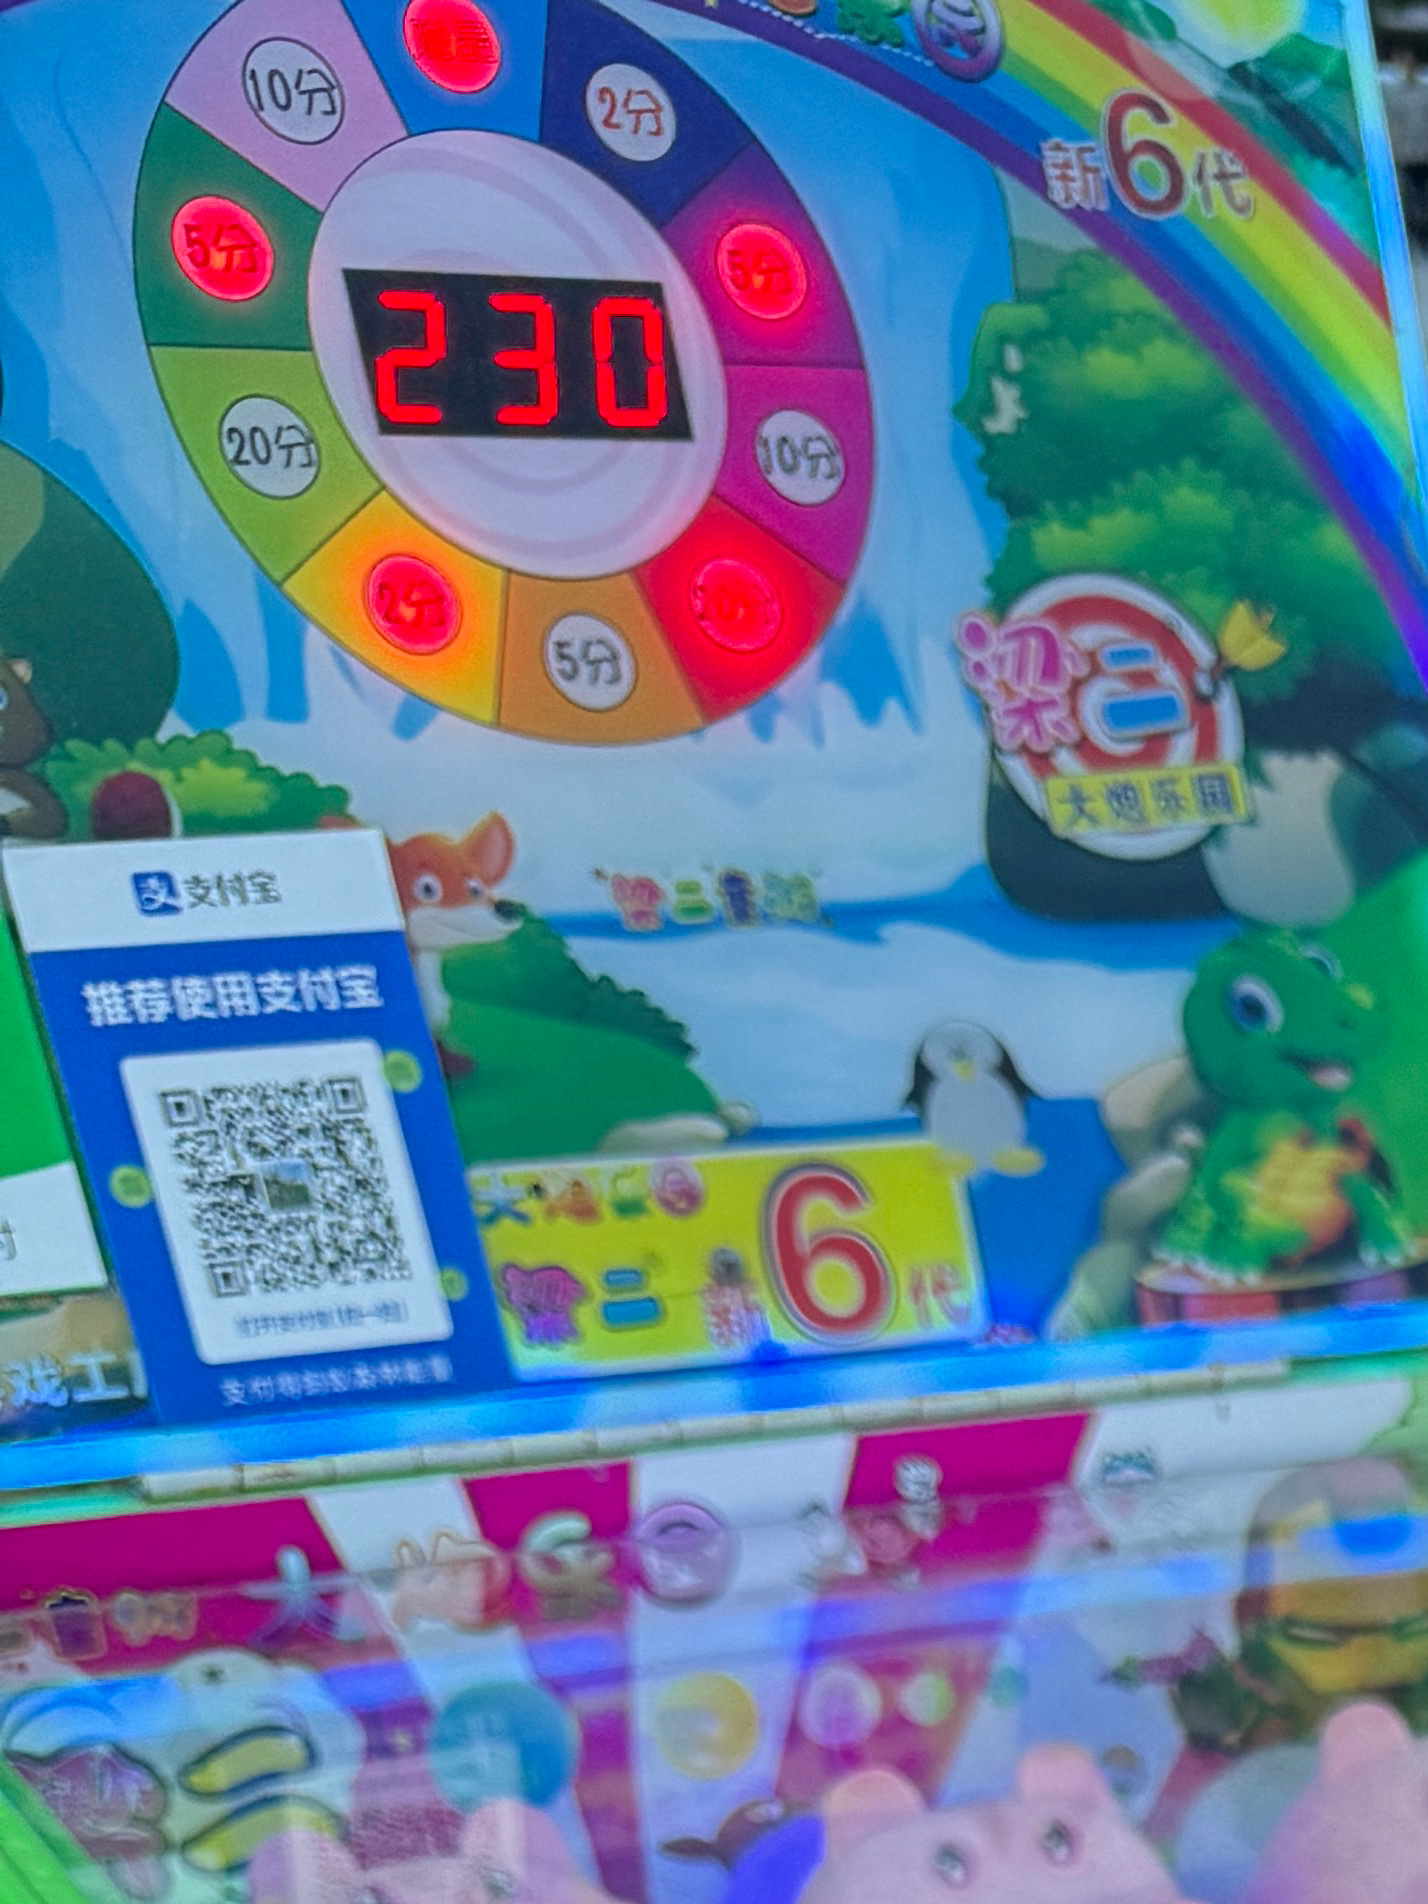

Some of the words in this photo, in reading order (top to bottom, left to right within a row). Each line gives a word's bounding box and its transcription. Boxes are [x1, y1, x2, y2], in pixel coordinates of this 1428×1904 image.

[249, 69, 337, 115] 10分
[598, 86, 664, 136] 2分
[1042, 90, 1254, 219] 新6代
[184, 224, 258, 273] 5分
[727, 249, 793, 294] 5分
[376, 290, 668, 428] 230
[226, 424, 315, 468] 20分
[760, 435, 841, 479] 10分
[378, 581, 445, 627] 2分
[552, 639, 622, 685] 5分
[183, 868, 282, 909] 支付宝
[82, 964, 384, 1027] 推荐使用支付宝
